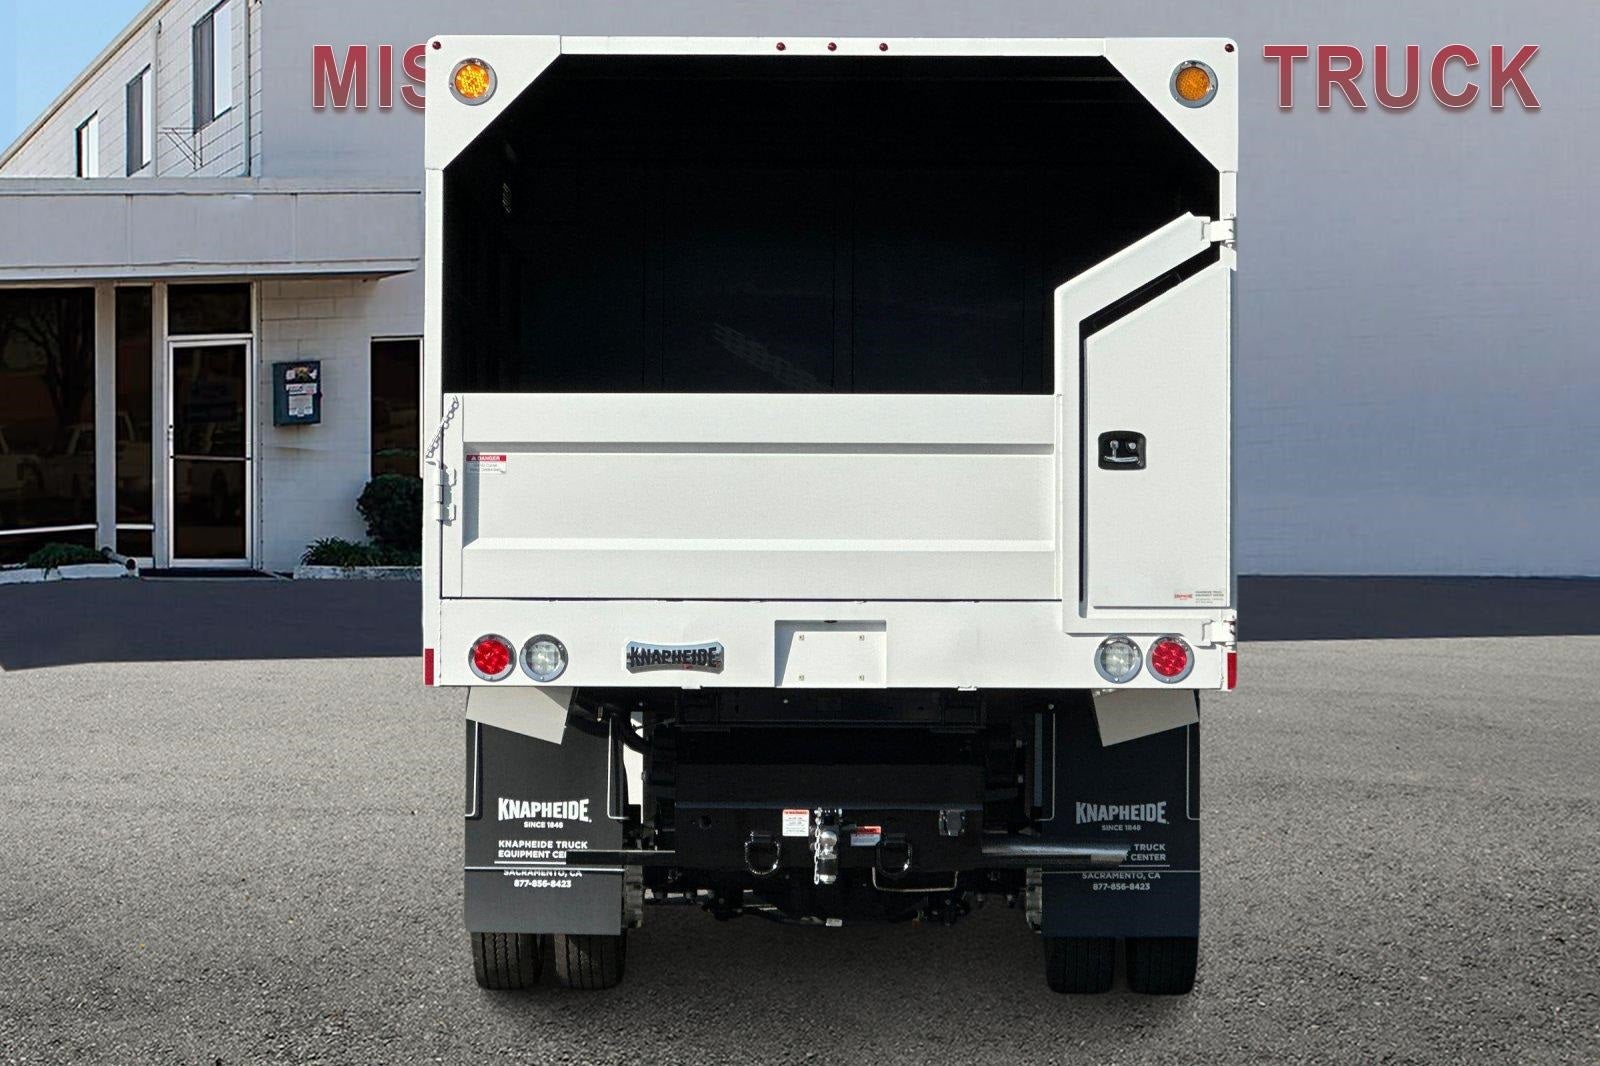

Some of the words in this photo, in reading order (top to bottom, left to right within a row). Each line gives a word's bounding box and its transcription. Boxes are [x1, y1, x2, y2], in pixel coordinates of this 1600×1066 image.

[1263, 44, 1541, 109] TRUCK
[630, 646, 717, 668] KNAPHEIDE
[498, 797, 590, 823] KNAPHEIDE
[1075, 801, 1168, 825] KNAPHEIDE
[523, 821, 546, 829] SINCE
[1101, 824, 1123, 832] SINCE
[498, 840, 553, 849] KNAPHEIDE
[556, 841, 588, 850] TRUCK
[498, 850, 551, 859] EQUIPMENT
[552, 851, 567, 859] CE
[1130, 853, 1166, 861] CENTER
[1082, 871, 1147, 881] SACRAMENTO,
[1148, 871, 1161, 880] CA
[513, 880, 572, 888] 877-856-8423
[1092, 882, 1151, 891] 877-856-8423
